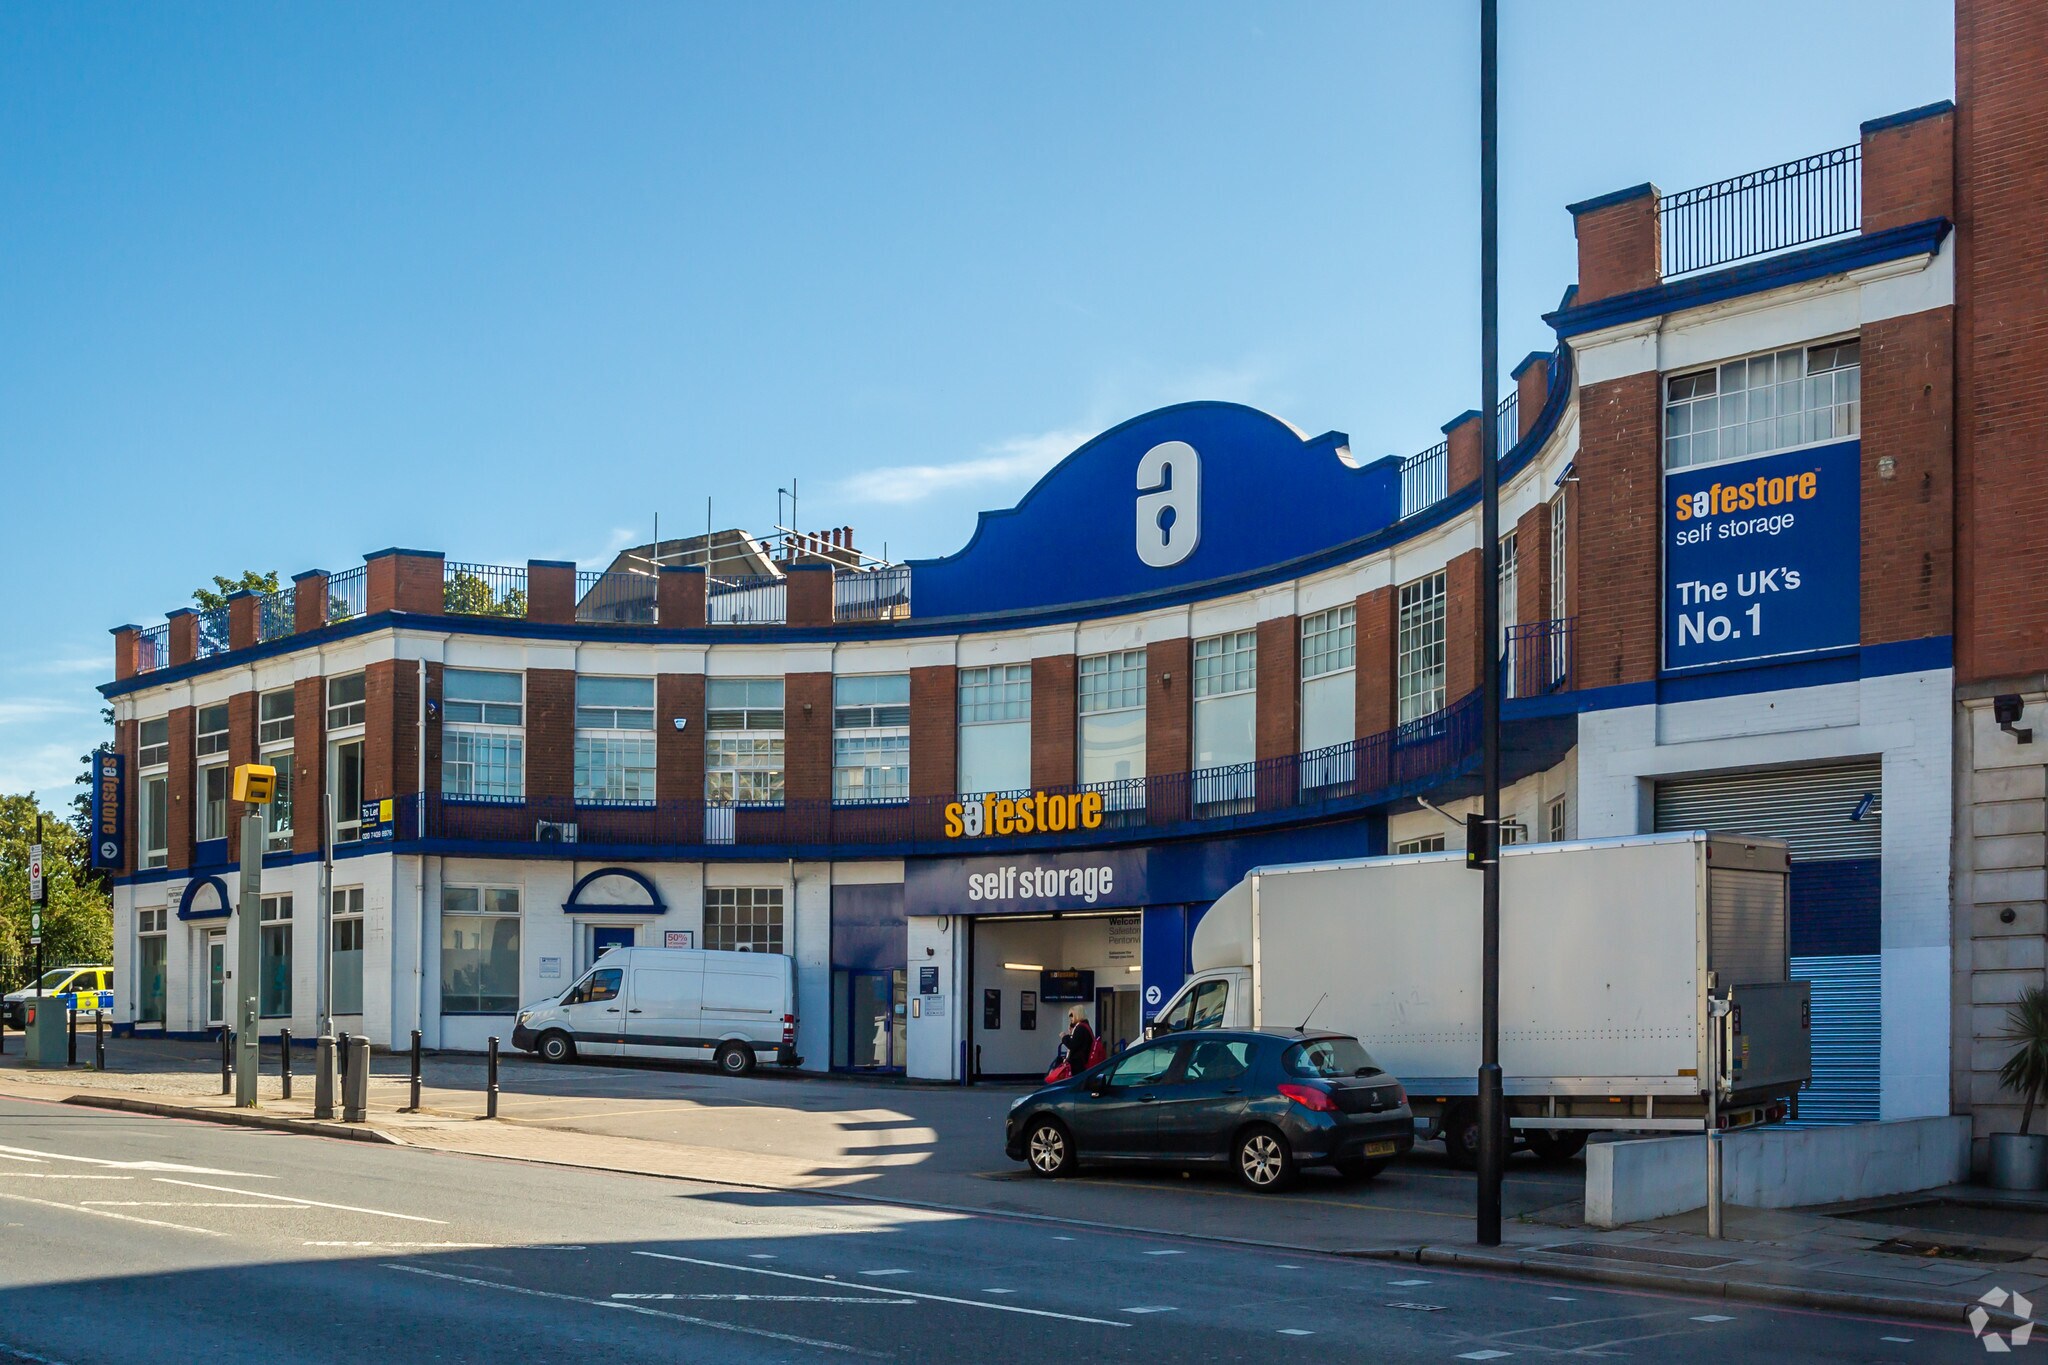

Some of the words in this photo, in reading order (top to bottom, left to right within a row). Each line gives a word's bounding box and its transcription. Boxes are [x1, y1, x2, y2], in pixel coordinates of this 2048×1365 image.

[1676, 471, 1816, 521] safestore
[1676, 522, 1712, 546] self
[1718, 513, 1795, 539] storage
[1676, 580, 1728, 606] The
[1737, 567, 1801, 597] UK's
[102, 757, 119, 834] safestore
[362, 809, 369, 817] To
[370, 808, 379, 816] Let
[945, 791, 1102, 838] safestore
[968, 866, 1017, 900] self
[1019, 866, 1113, 903] storage
[667, 933, 688, 941] 50%
[1109, 927, 1141, 935] Safestor
